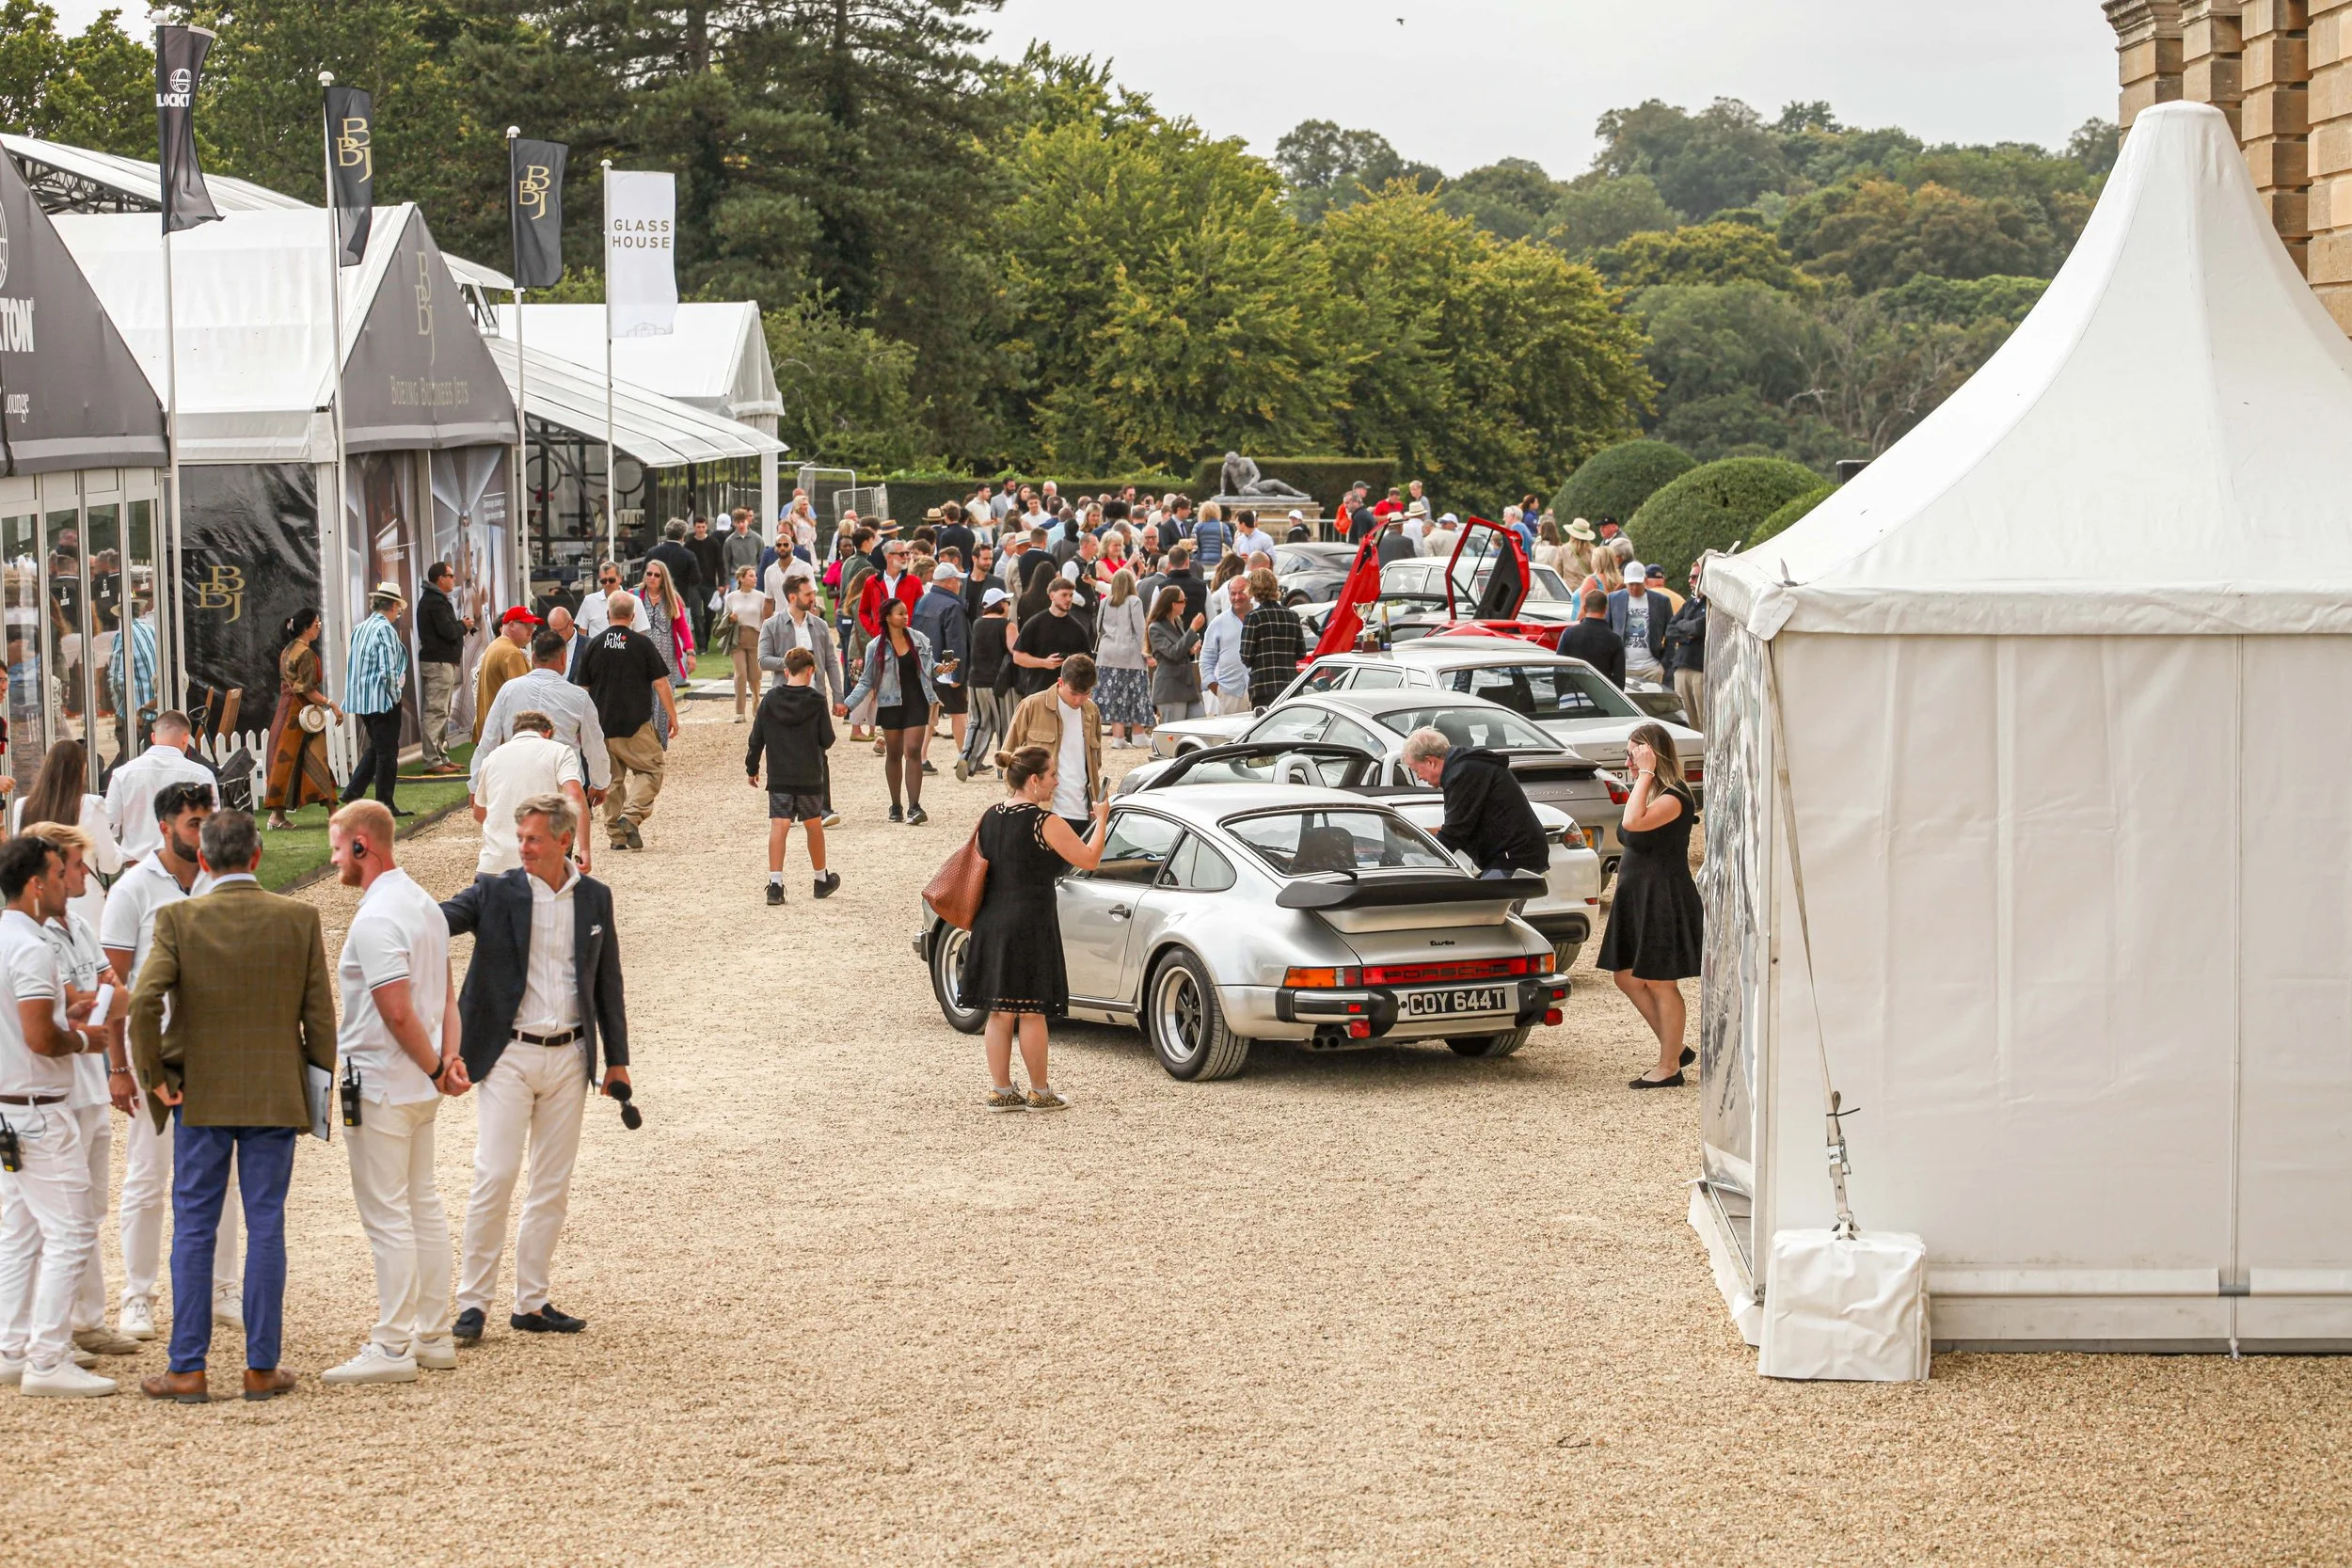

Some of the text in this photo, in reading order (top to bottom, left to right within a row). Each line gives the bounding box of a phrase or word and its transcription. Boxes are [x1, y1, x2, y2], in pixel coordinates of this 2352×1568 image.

[155, 93, 191, 107] LOCKT
[613, 218, 670, 232] GLASS
[612, 235, 671, 249] HOUSE
[0, 297, 35, 353] TON
[603, 641, 626, 649] PUNK
[1383, 963, 1510, 981] PORSCHE
[1453, 990, 1504, 1012] 644T
